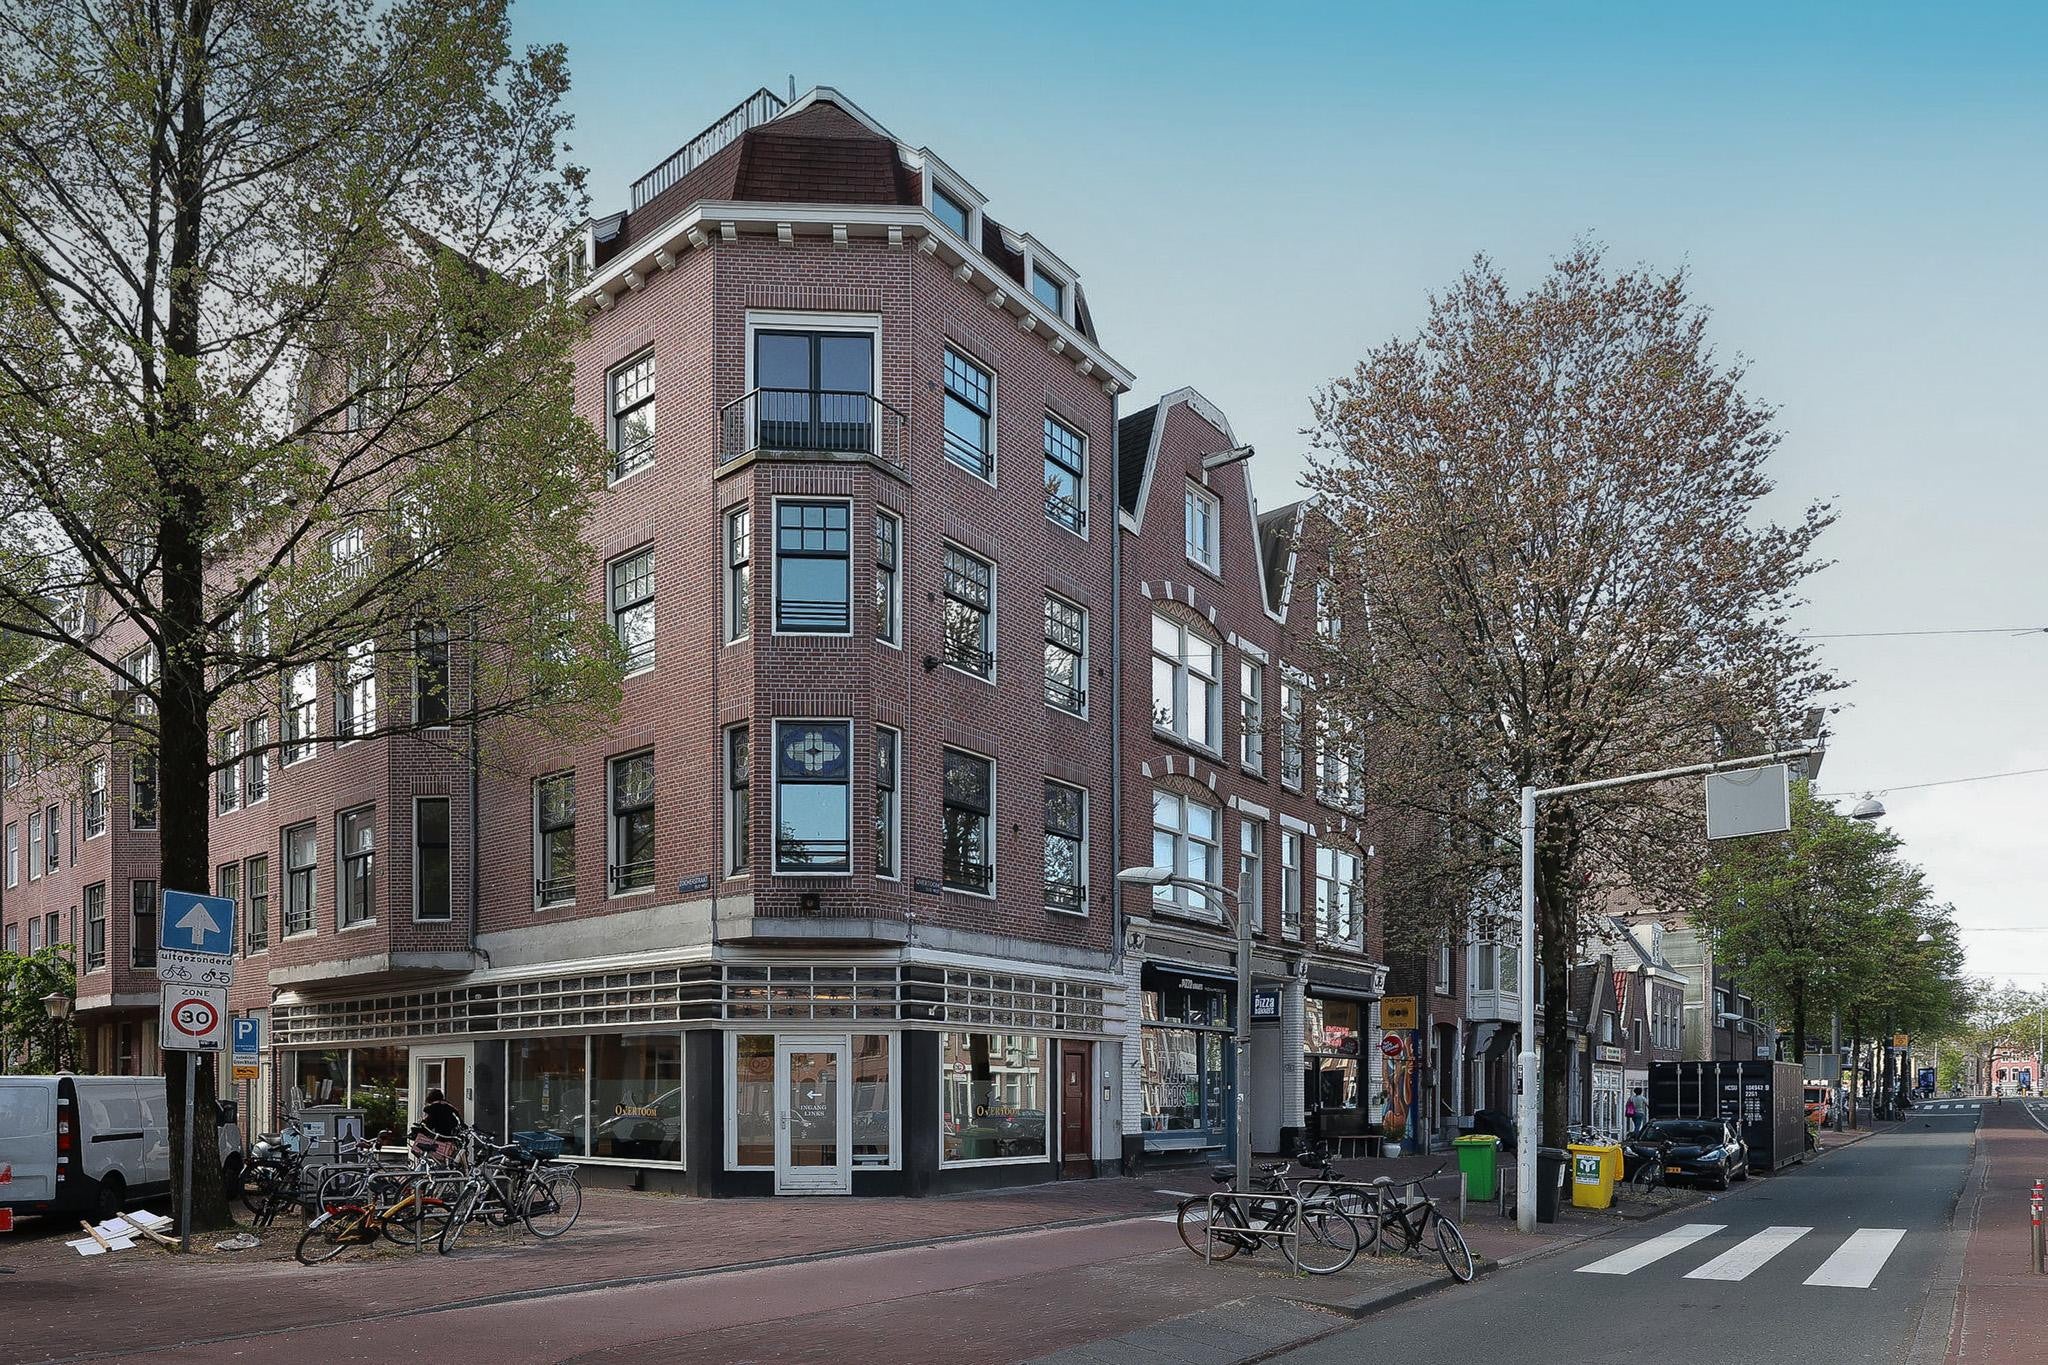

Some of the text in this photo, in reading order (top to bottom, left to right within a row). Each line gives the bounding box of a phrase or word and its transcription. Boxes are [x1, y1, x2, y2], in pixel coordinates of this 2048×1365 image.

[161, 952, 232, 966] uitgezonderd
[181, 988, 210, 998] ZONE
[180, 1010, 210, 1025] 30
[239, 1021, 253, 1040] P
